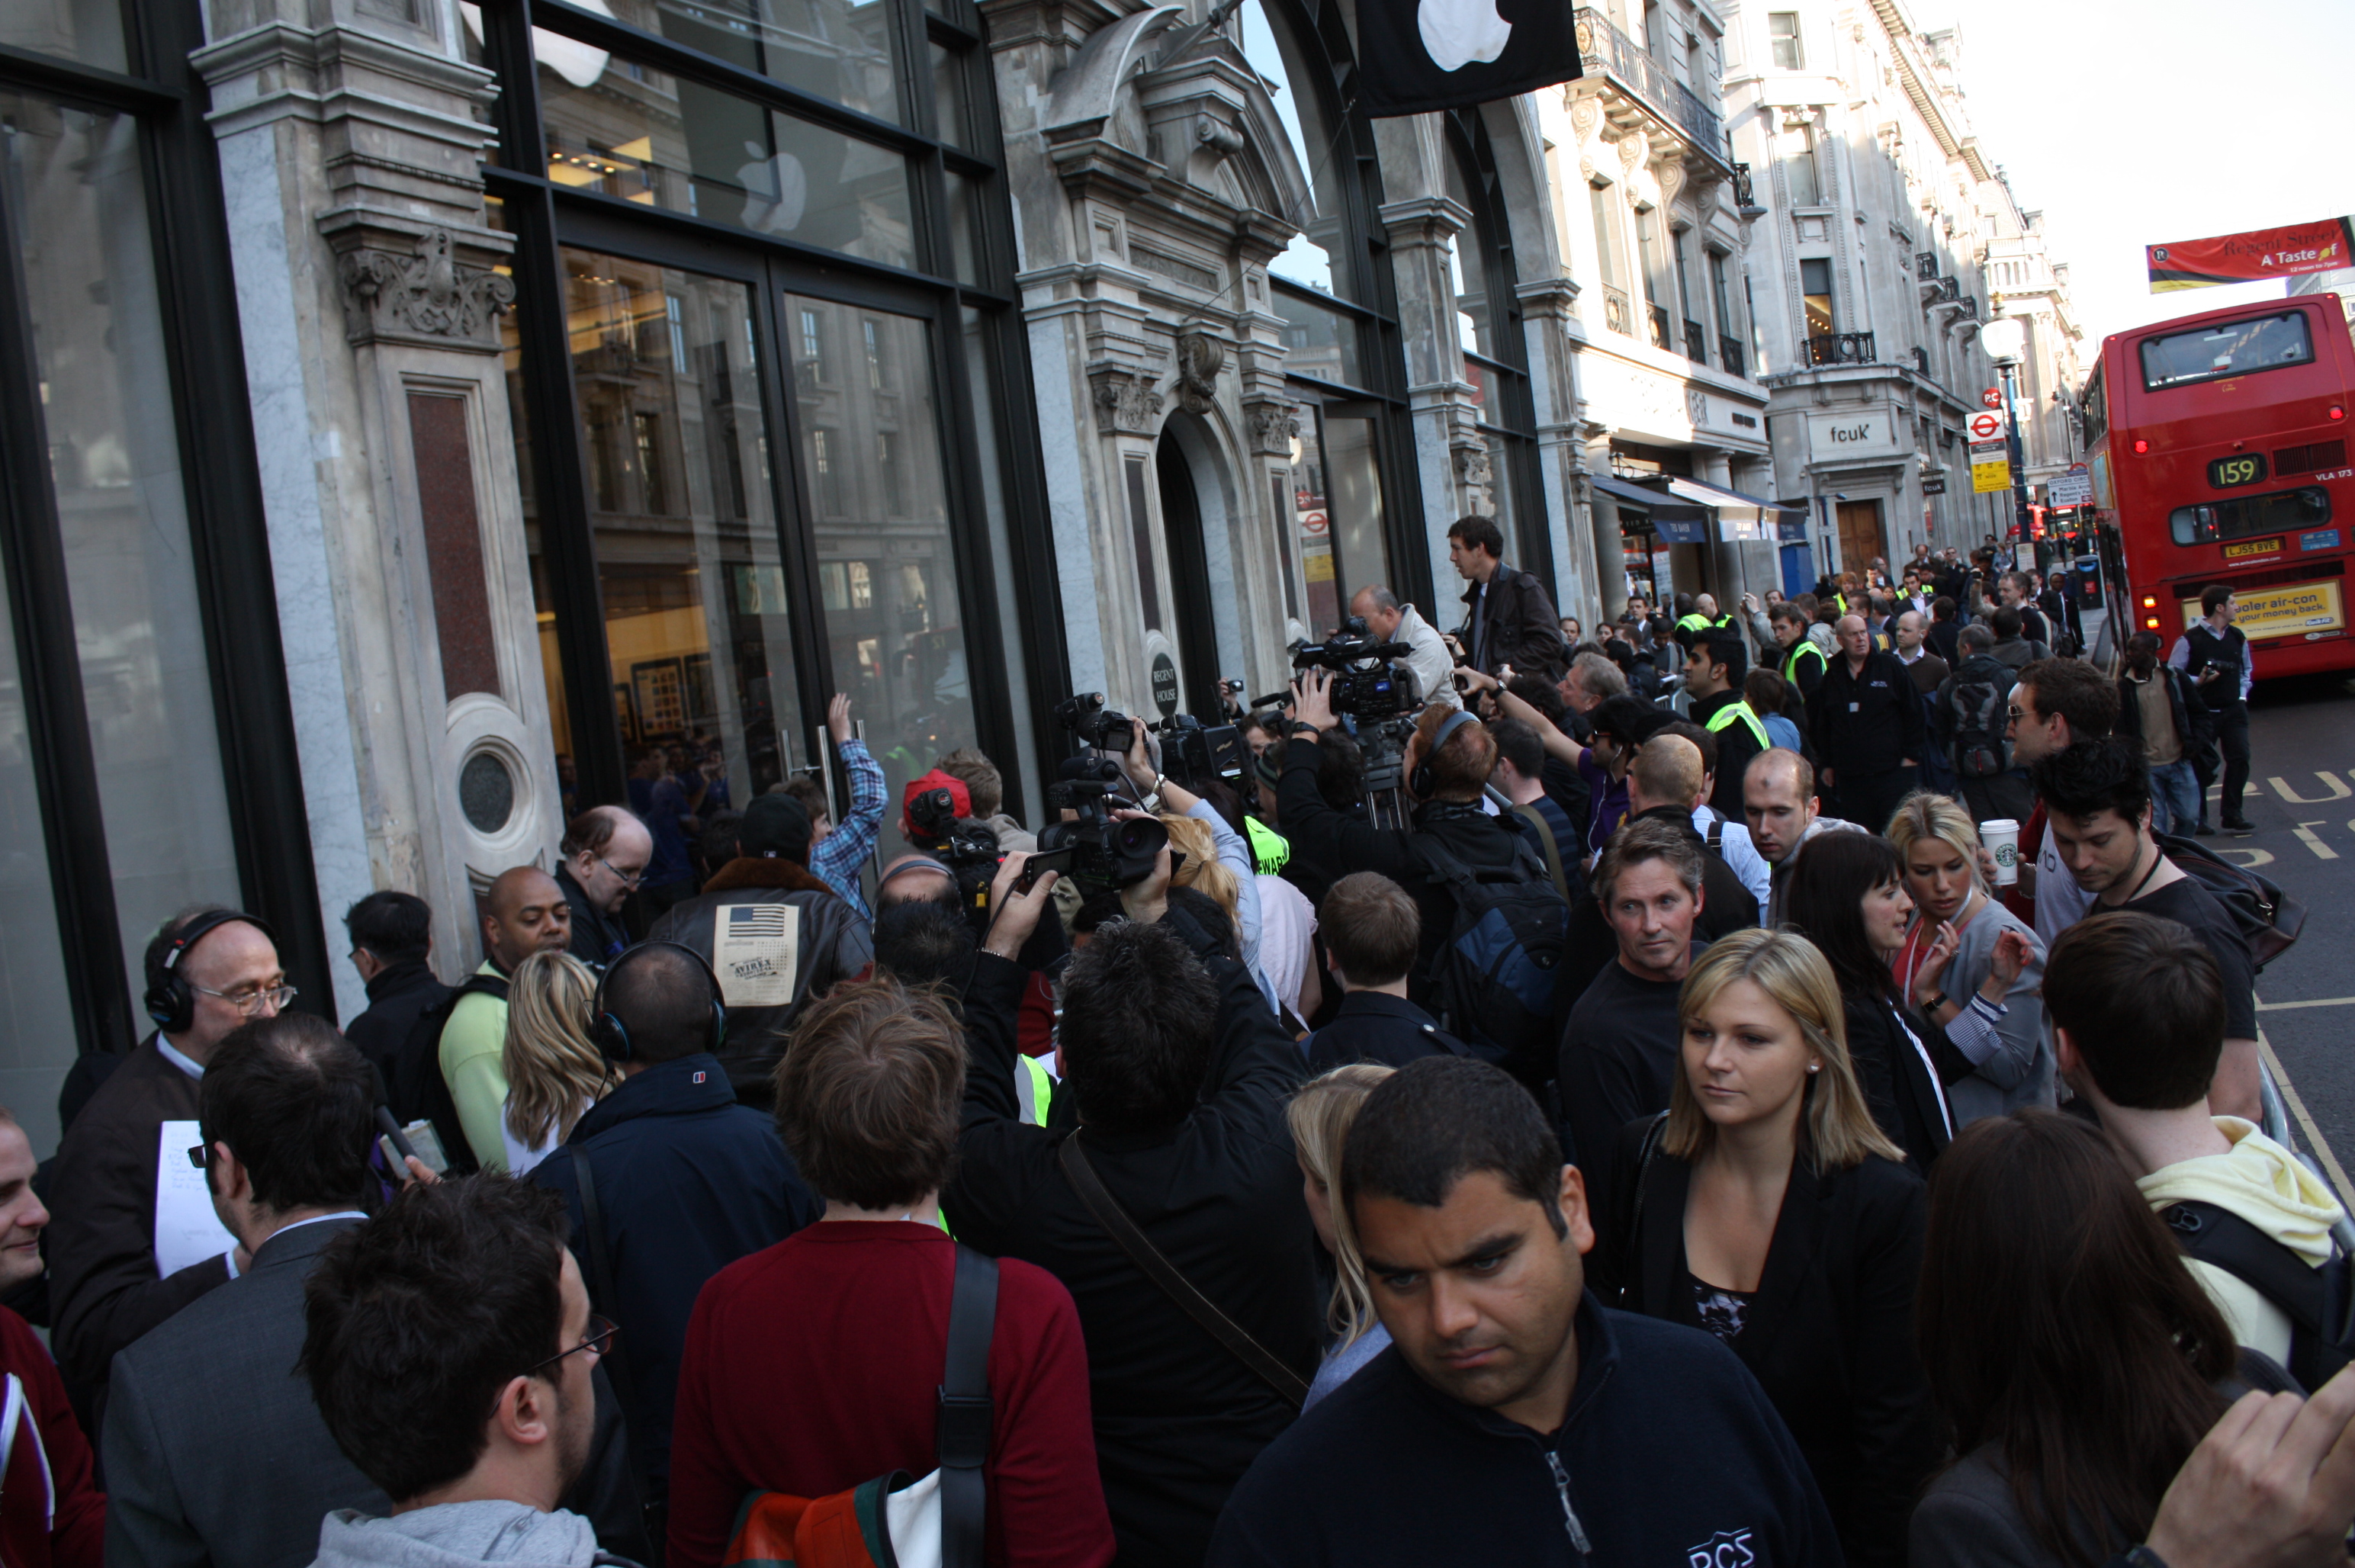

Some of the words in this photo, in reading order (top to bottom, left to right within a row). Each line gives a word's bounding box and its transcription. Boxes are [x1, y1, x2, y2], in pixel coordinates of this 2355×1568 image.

[2224, 240, 2282, 256] Regent
[2287, 230, 2337, 247] Street
[2261, 255, 2273, 267] A
[2276, 249, 2317, 264] Taste
[1830, 424, 1869, 443] fcuk
[2218, 460, 2254, 485] 159
[2315, 473, 2335, 481] VLA
[2337, 468, 2353, 478] 173
[1924, 483, 1942, 492] fcuk
[2229, 544, 2255, 556] LJ55
[2257, 541, 2276, 551] BVE
[2235, 601, 2267, 613] ooler
[2270, 594, 2318, 609] air-con
[2238, 613, 2261, 624] your
[2263, 607, 2298, 618] money
[2299, 602, 2326, 613] back.
[1153, 668, 1174, 683] REGENT
[1156, 688, 1176, 702] HOUSE
[1257, 855, 1286, 876] EWAR
